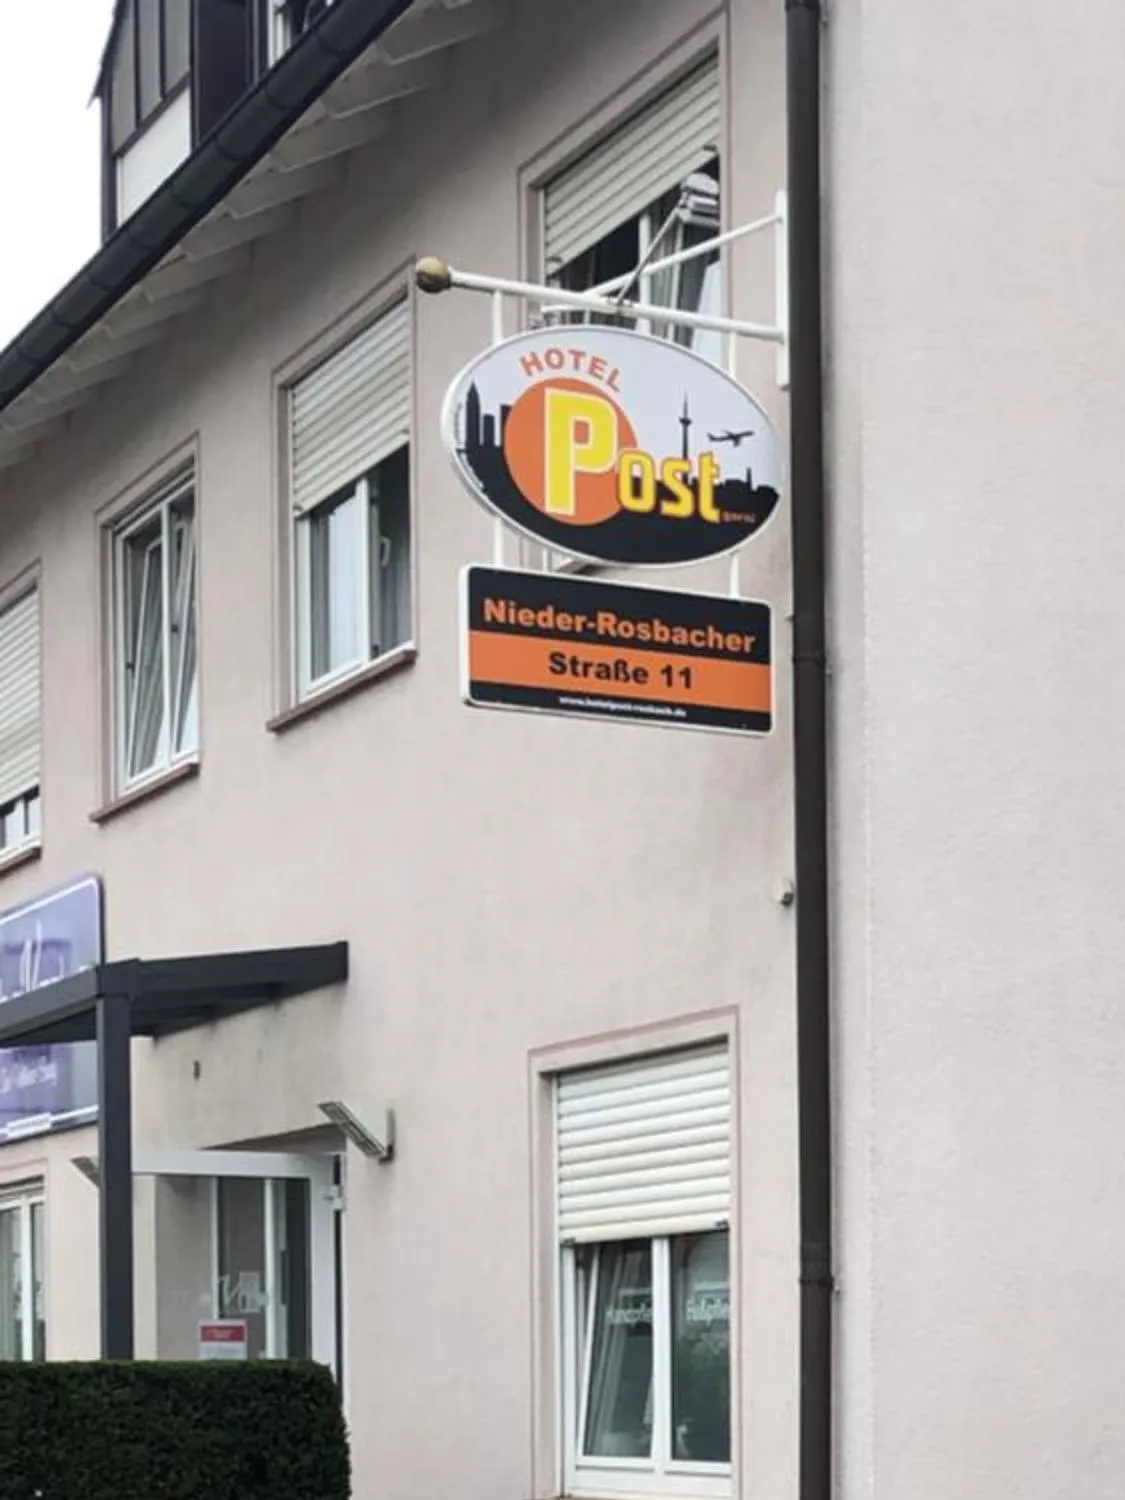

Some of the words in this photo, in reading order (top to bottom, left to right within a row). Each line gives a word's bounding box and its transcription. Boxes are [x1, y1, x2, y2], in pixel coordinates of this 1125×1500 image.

[519, 347, 622, 393] HOTEL
[544, 386, 722, 525] Post
[483, 597, 757, 653] Nieder-Rosbacher
[548, 651, 650, 686] Straße
[660, 663, 694, 691] 11
